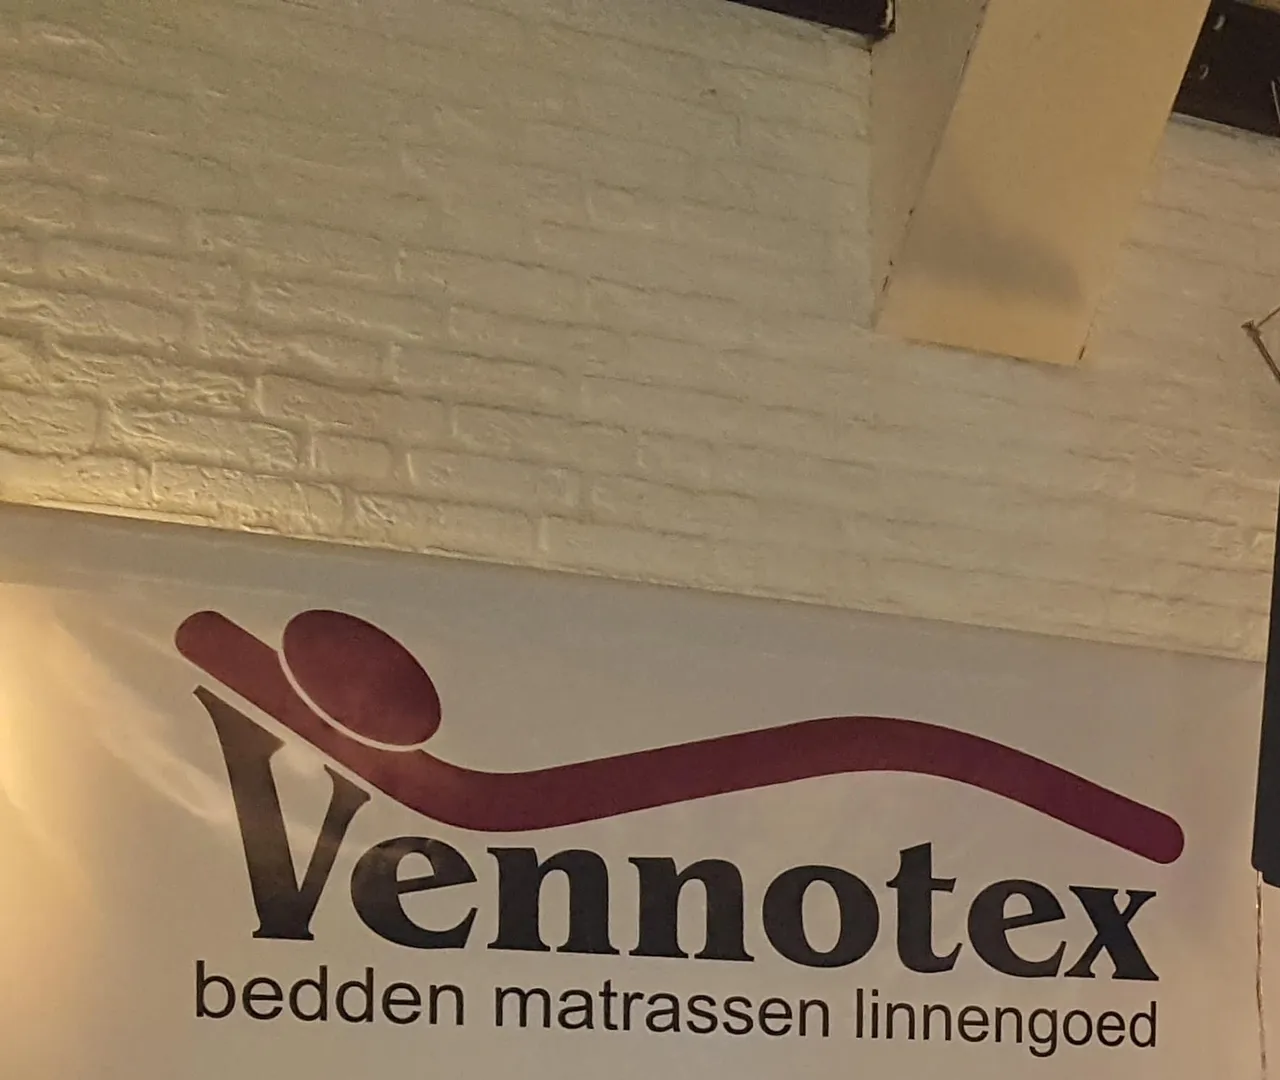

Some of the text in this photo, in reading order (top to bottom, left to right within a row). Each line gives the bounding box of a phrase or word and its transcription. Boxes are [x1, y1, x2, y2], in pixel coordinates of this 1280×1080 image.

[193, 685, 1160, 982] Vennotex
[196, 959, 1159, 1058] bedden matrassen linnengoed
